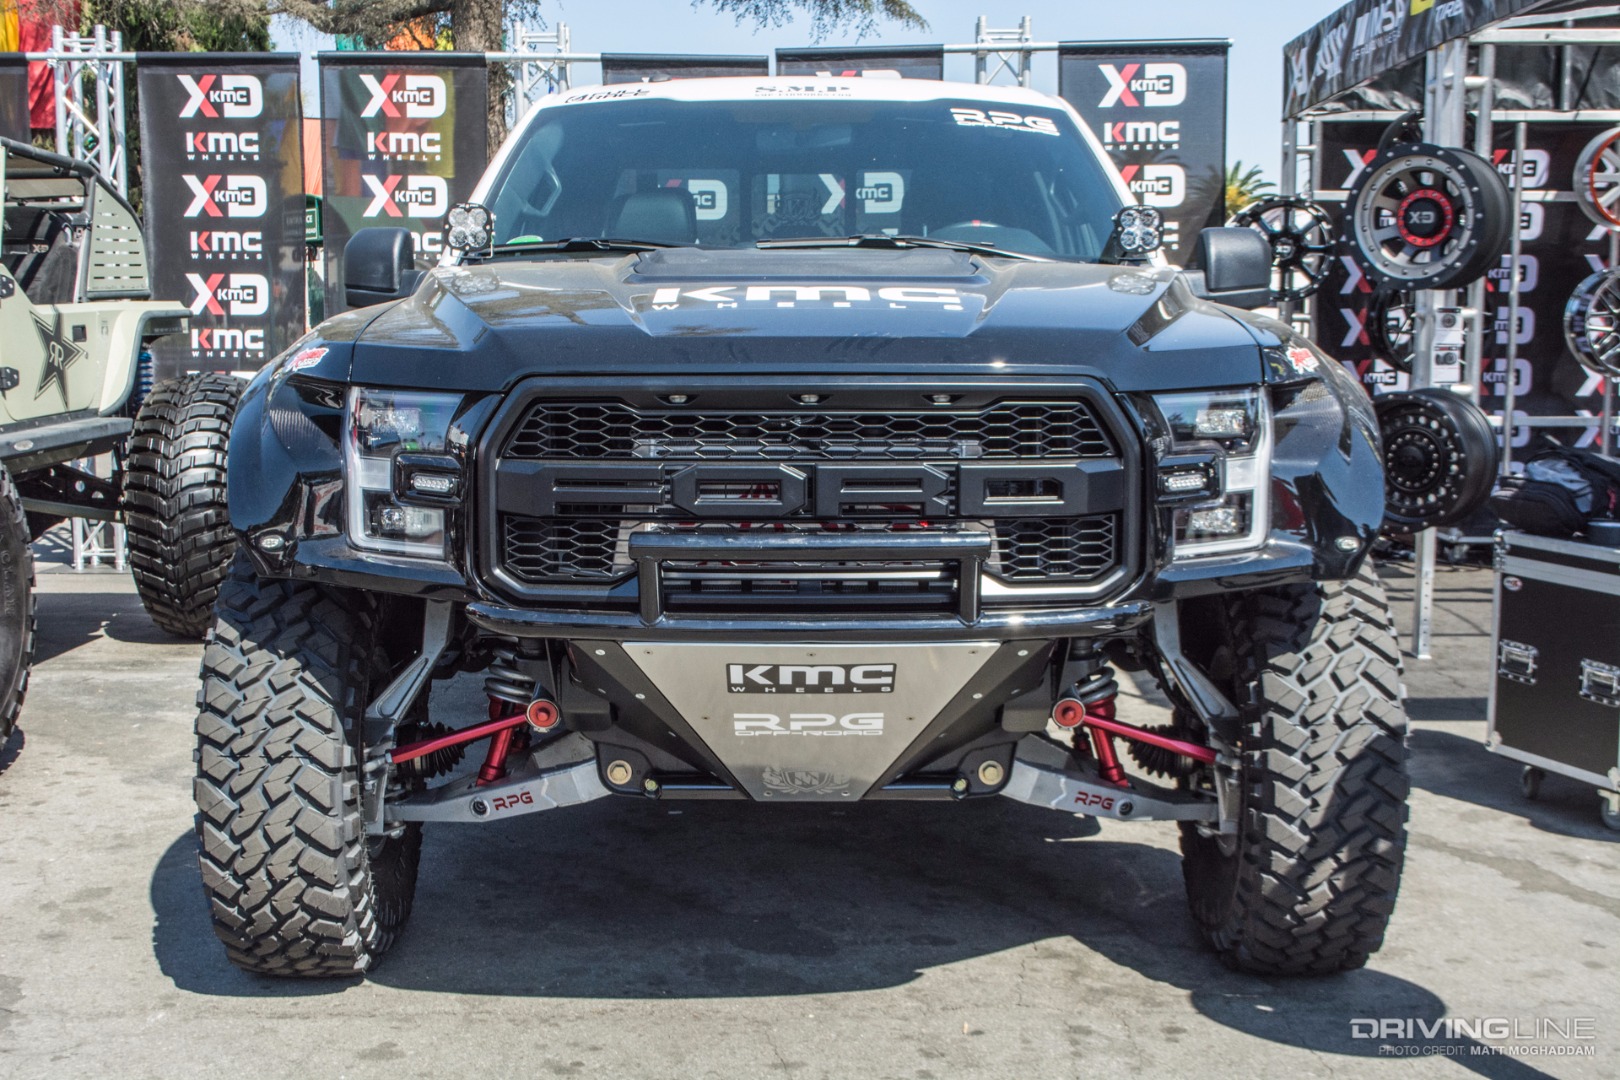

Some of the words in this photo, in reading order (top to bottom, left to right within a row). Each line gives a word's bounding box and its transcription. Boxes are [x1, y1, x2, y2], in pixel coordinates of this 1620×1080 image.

[1097, 63, 1187, 107] XD
[177, 74, 263, 118] XD
[359, 74, 447, 118] XD
[950, 108, 1058, 132] RPG
[186, 132, 259, 152] KMC
[367, 132, 441, 152] KMC
[1104, 121, 1180, 142] KMC
[182, 174, 267, 217] XD
[362, 174, 448, 217] XD
[1409, 211, 1435, 224] XD
[190, 231, 262, 252] KMC
[185, 273, 269, 316] XD
[652, 286, 961, 304] KMC
[652, 302, 963, 311] WHEELS
[191, 328, 264, 349] KMC
[498, 461, 1120, 518] FORD
[729, 664, 894, 685] KMC
[733, 712, 884, 731] RPG
[492, 791, 534, 811] RPG
[1074, 791, 1115, 811] RPG
